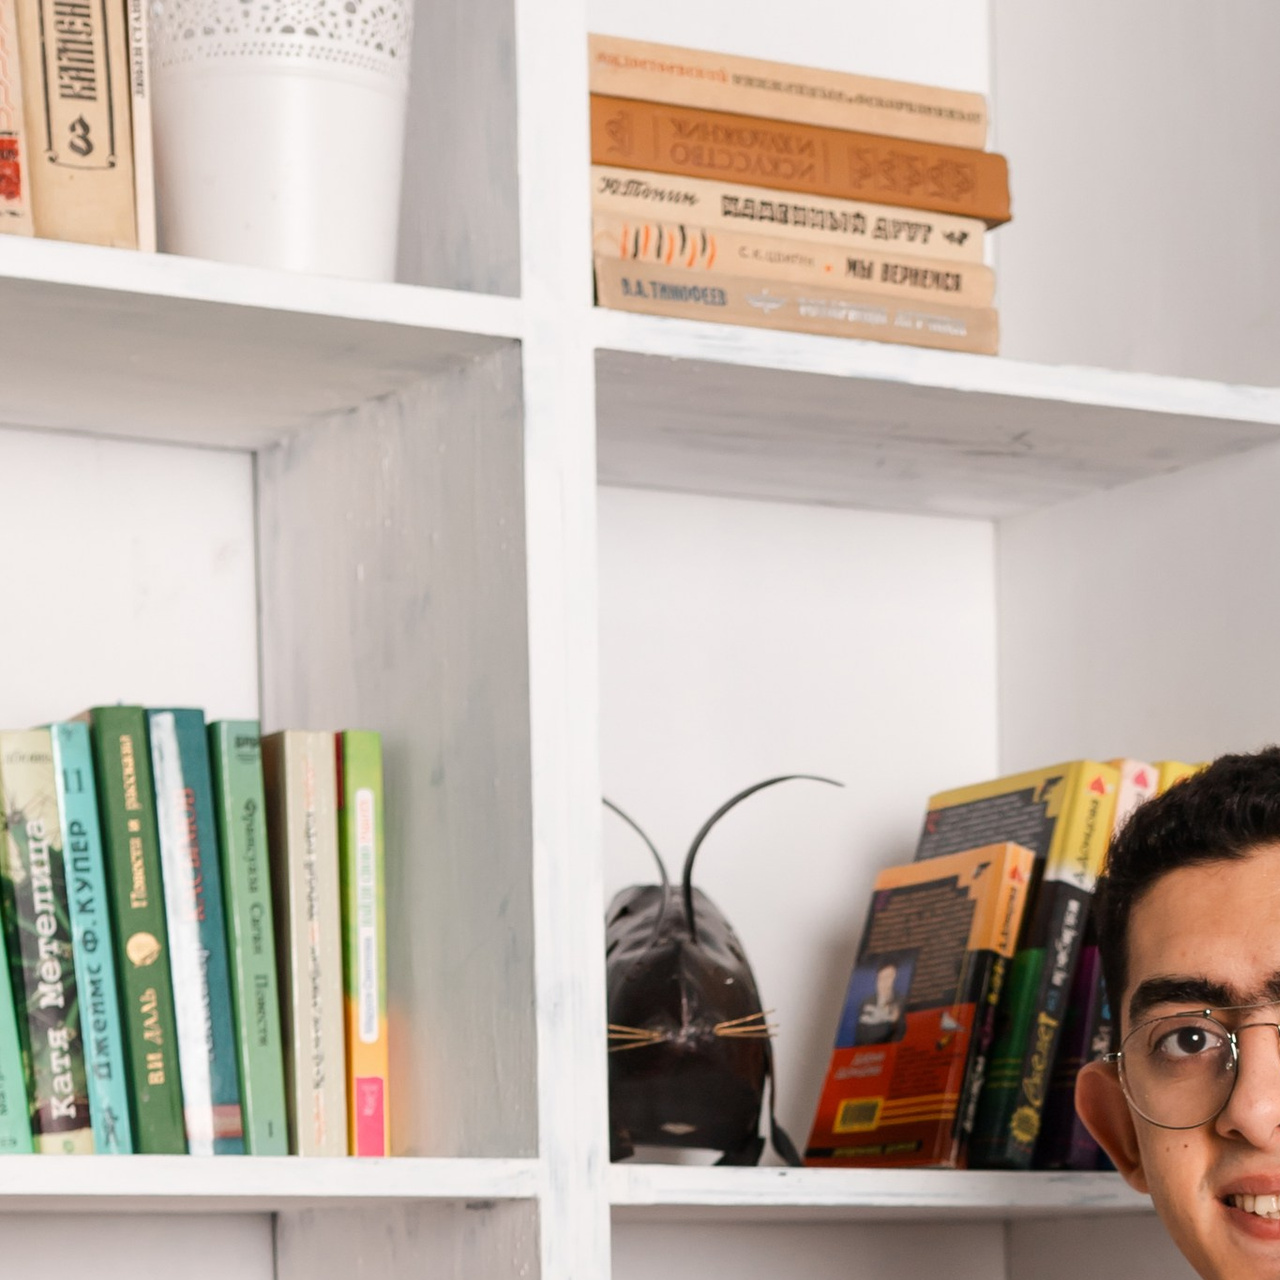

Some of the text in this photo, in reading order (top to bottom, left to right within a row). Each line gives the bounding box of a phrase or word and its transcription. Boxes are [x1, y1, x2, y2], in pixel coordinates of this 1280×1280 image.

[19, 816, 77, 1121] Катя Метелица
[79, 962, 116, 1082] Джеймс
